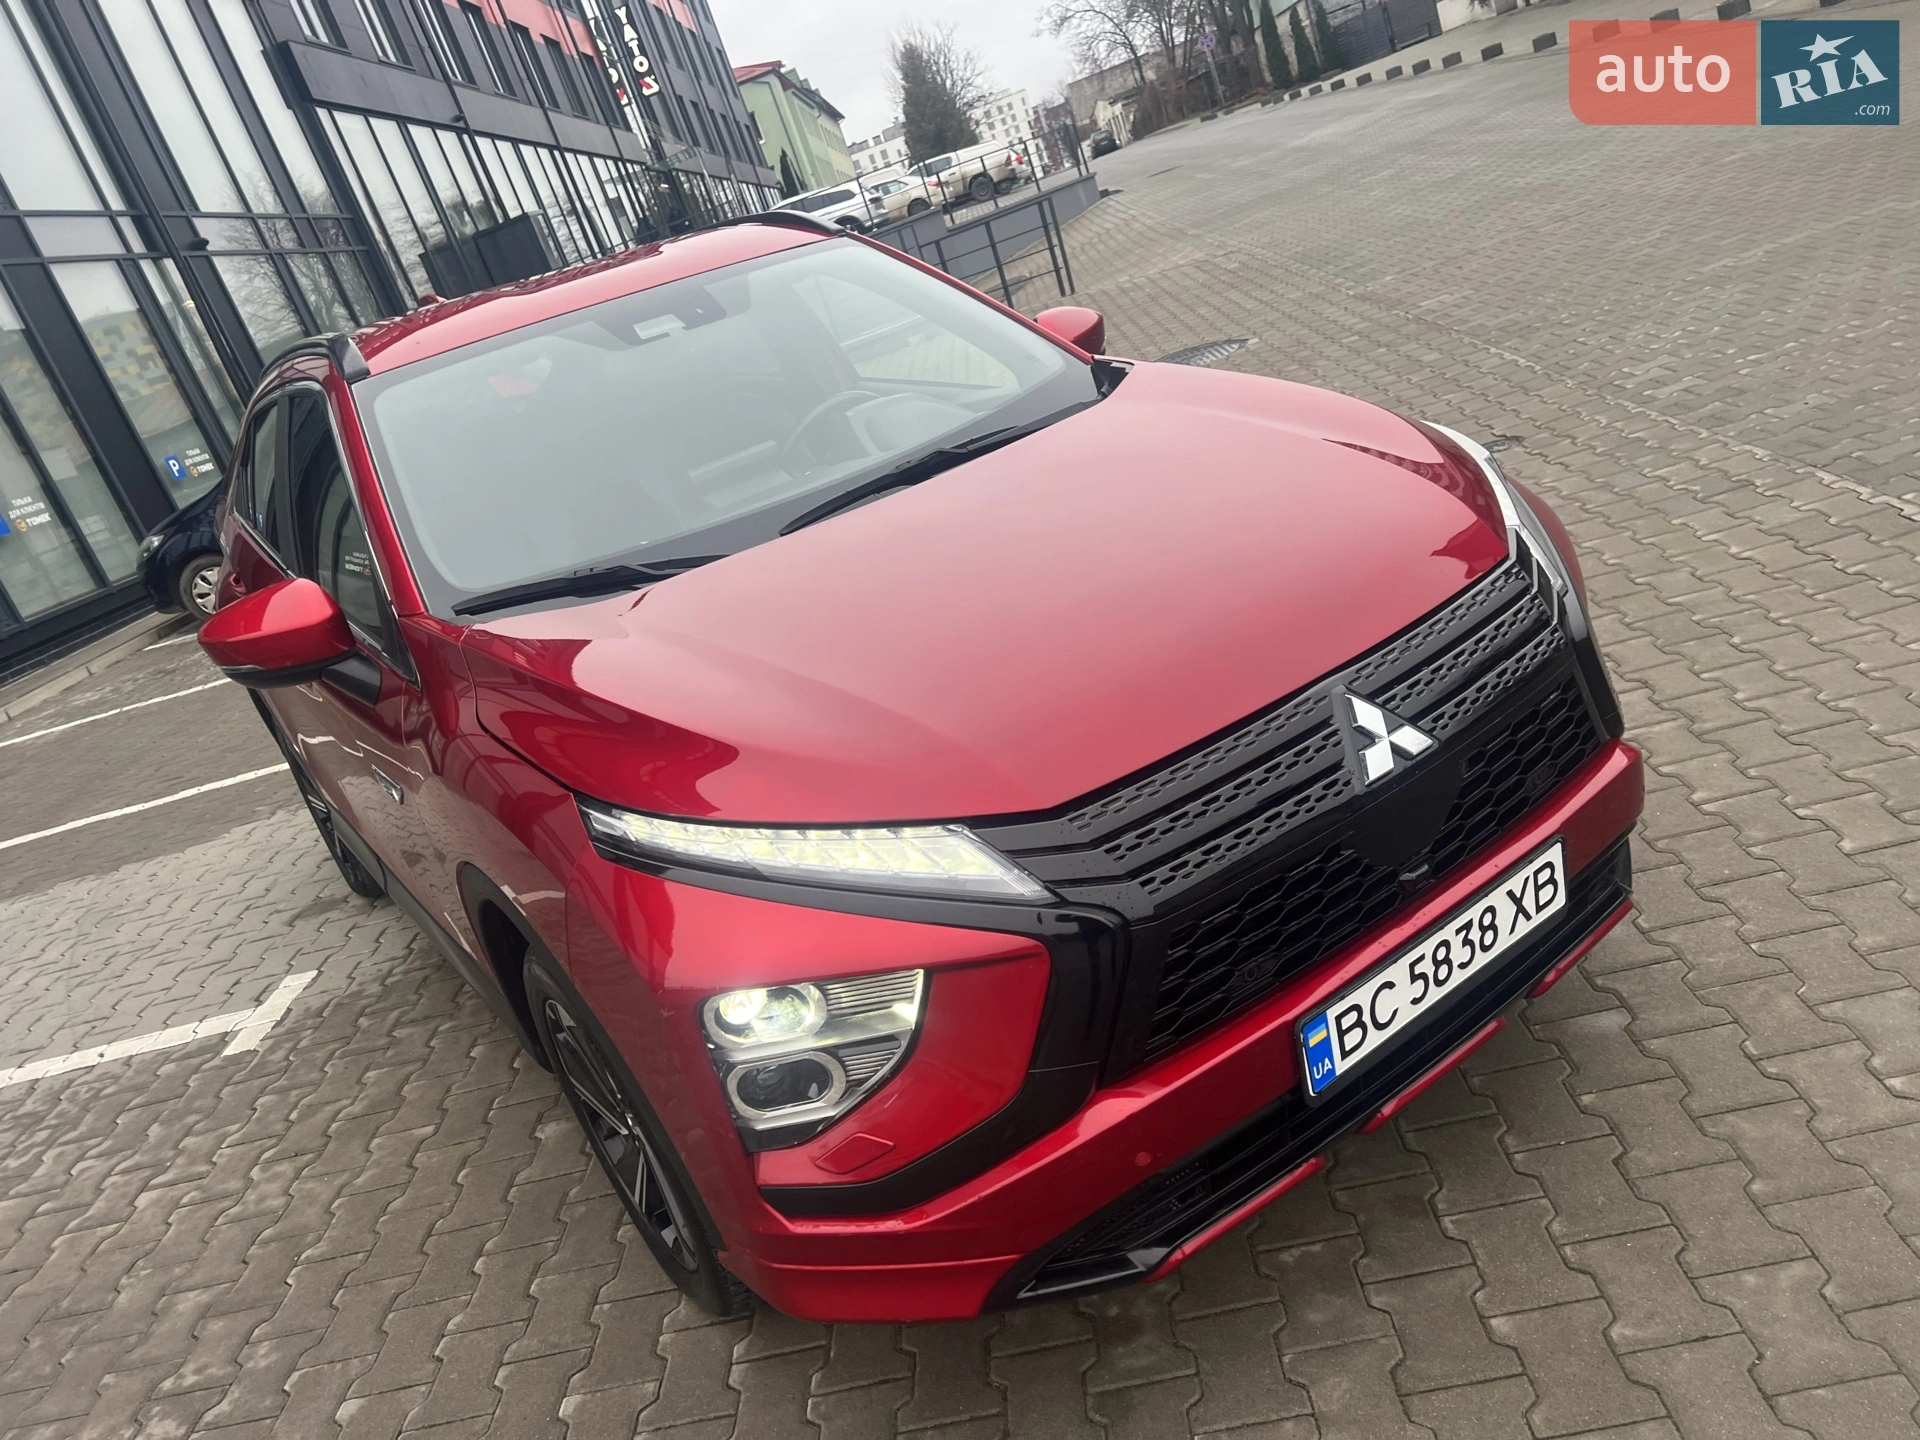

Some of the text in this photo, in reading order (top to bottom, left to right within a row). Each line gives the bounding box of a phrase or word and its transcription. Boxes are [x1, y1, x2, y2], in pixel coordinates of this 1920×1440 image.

[614, 6, 650, 73] YATO
[168, 459, 180, 477] P
[1335, 859, 1560, 1063] BC 5838 XB
[1313, 1061, 1334, 1080] UA
